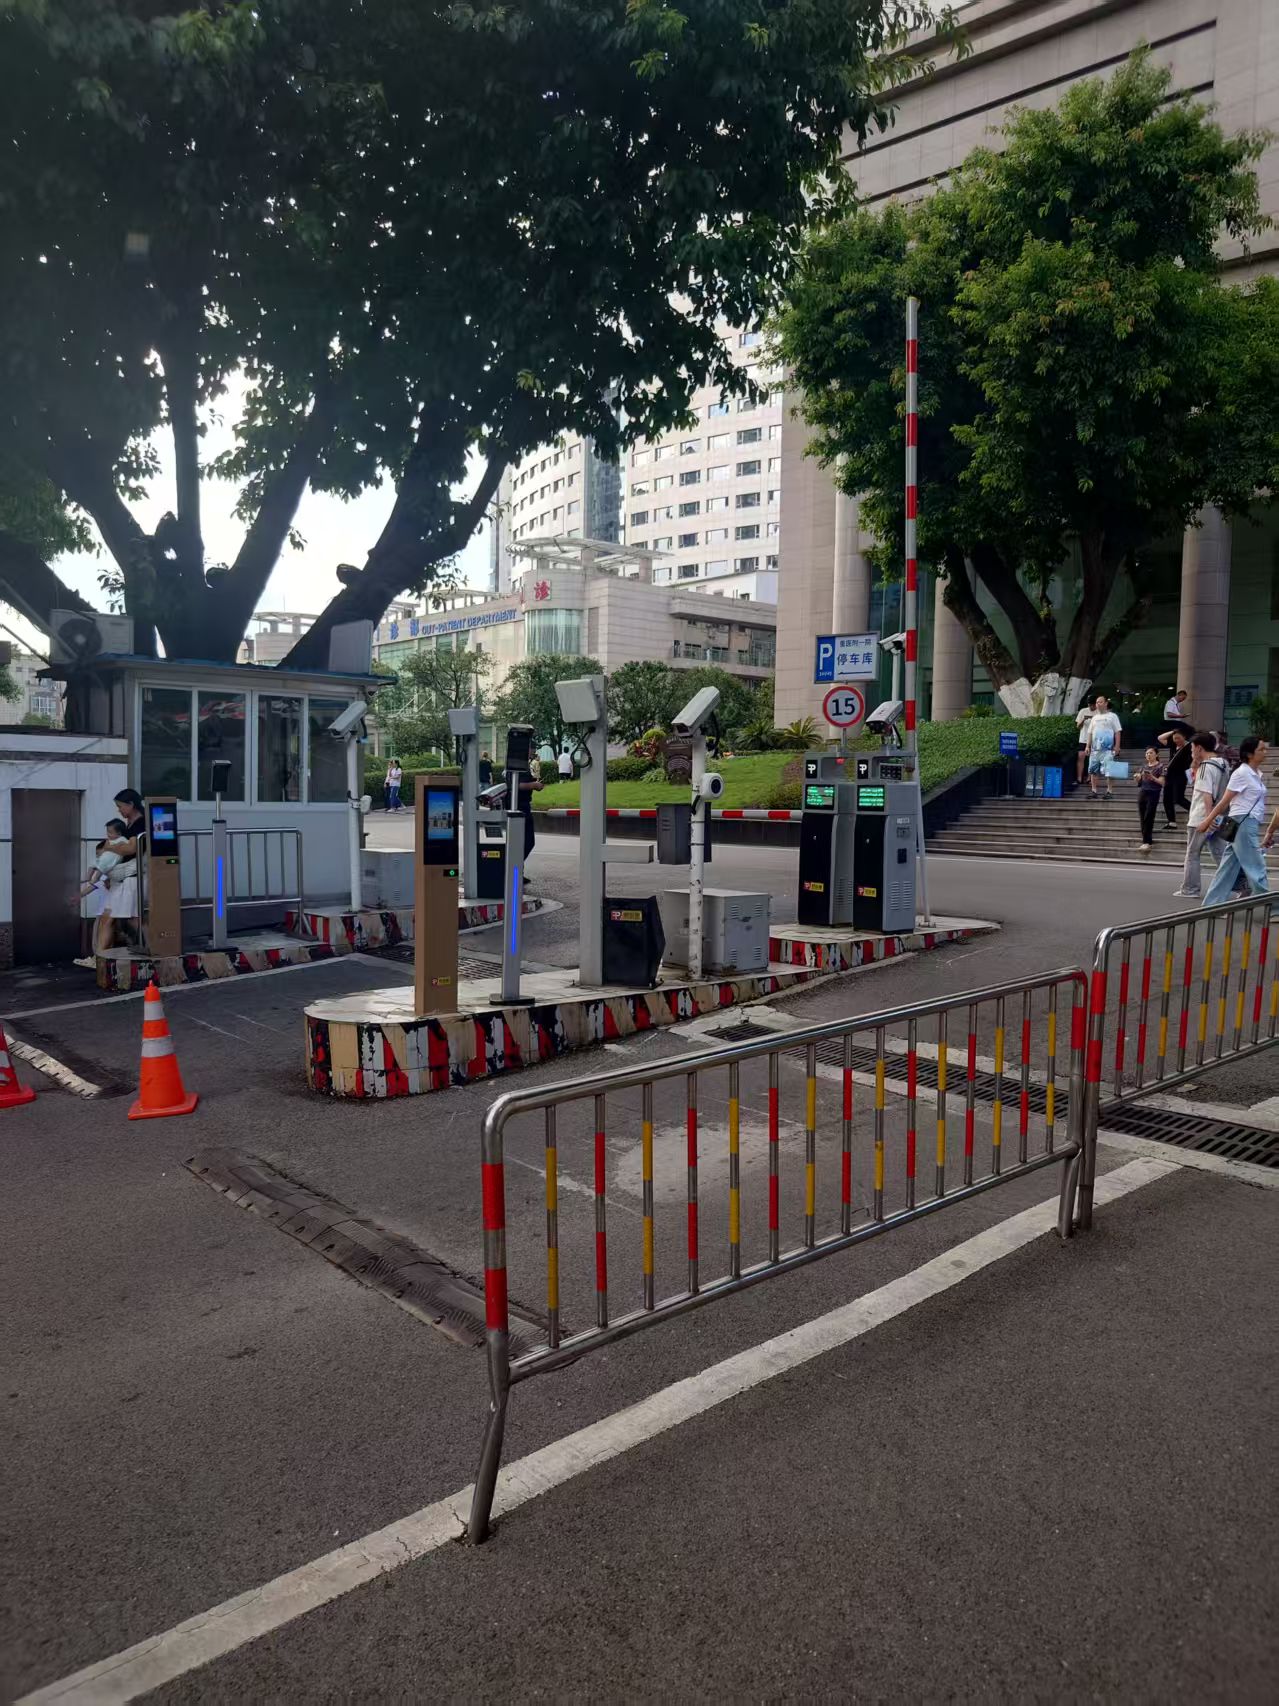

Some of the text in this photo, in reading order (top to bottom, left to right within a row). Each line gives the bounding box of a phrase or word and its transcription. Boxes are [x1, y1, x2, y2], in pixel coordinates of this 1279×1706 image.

[421, 608, 517, 635] OUT-PATIENT DEPARTMENT
[820, 643, 832, 670] P
[837, 652, 873, 666] 停车库
[832, 698, 855, 716] 15
